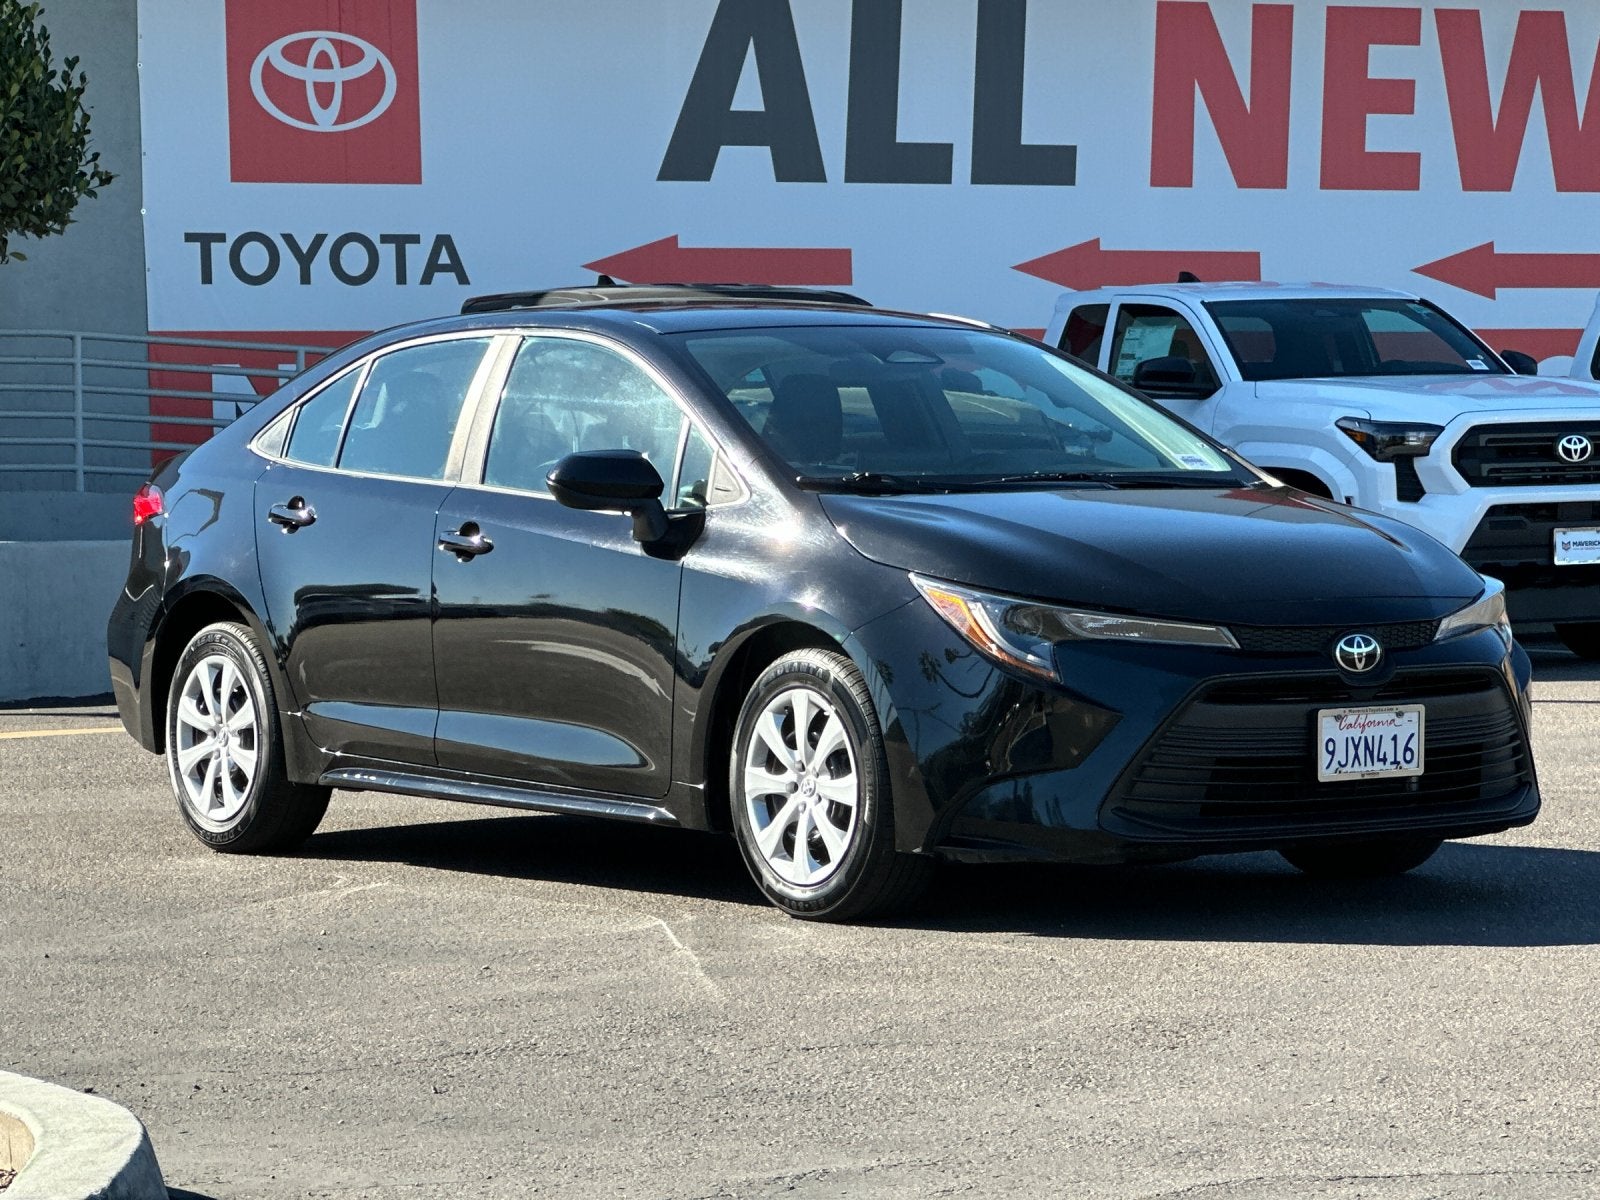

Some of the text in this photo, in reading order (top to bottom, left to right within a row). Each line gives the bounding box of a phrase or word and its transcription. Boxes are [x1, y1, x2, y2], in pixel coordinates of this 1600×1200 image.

[656, 0, 1600, 192] ALL NEW
[183, 231, 471, 286] TOYOTA
[1339, 714, 1402, 734] California
[1325, 733, 1415, 770] 9JXN416
